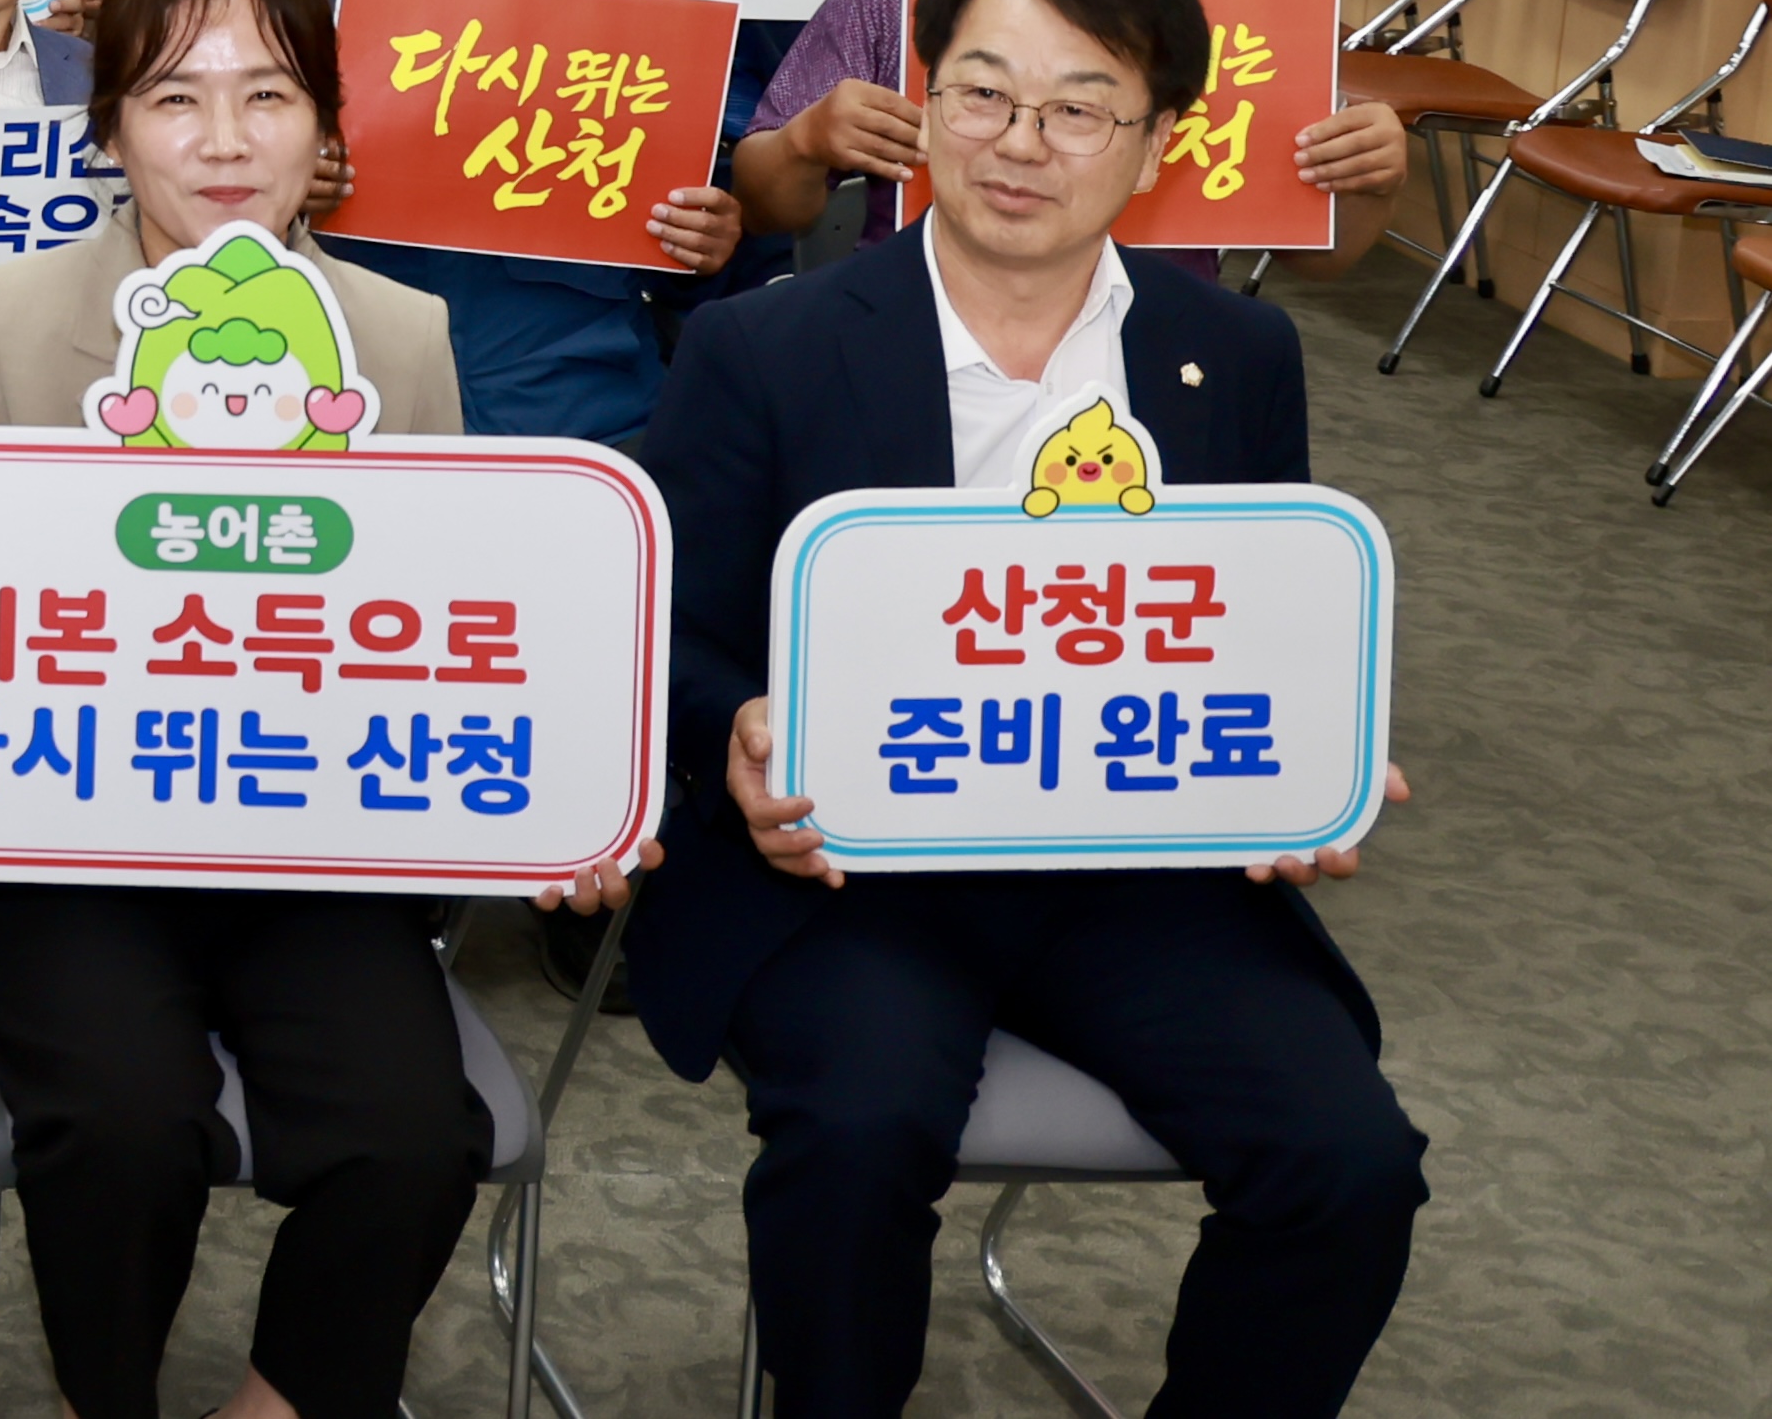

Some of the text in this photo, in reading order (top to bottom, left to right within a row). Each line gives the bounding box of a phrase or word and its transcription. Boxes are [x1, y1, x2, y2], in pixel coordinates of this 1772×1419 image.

[390, 18, 672, 137] 다시 뛰는
[463, 108, 646, 220] 산청
[1161, 99, 1255, 201] 청
[149, 502, 319, 566] 농어촌
[145, 592, 528, 694] 소득으로
[941, 563, 1226, 666] 산청군
[131, 707, 318, 809] 뛰는
[346, 712, 533, 816] 산청
[878, 691, 1281, 794] 준비 완료
